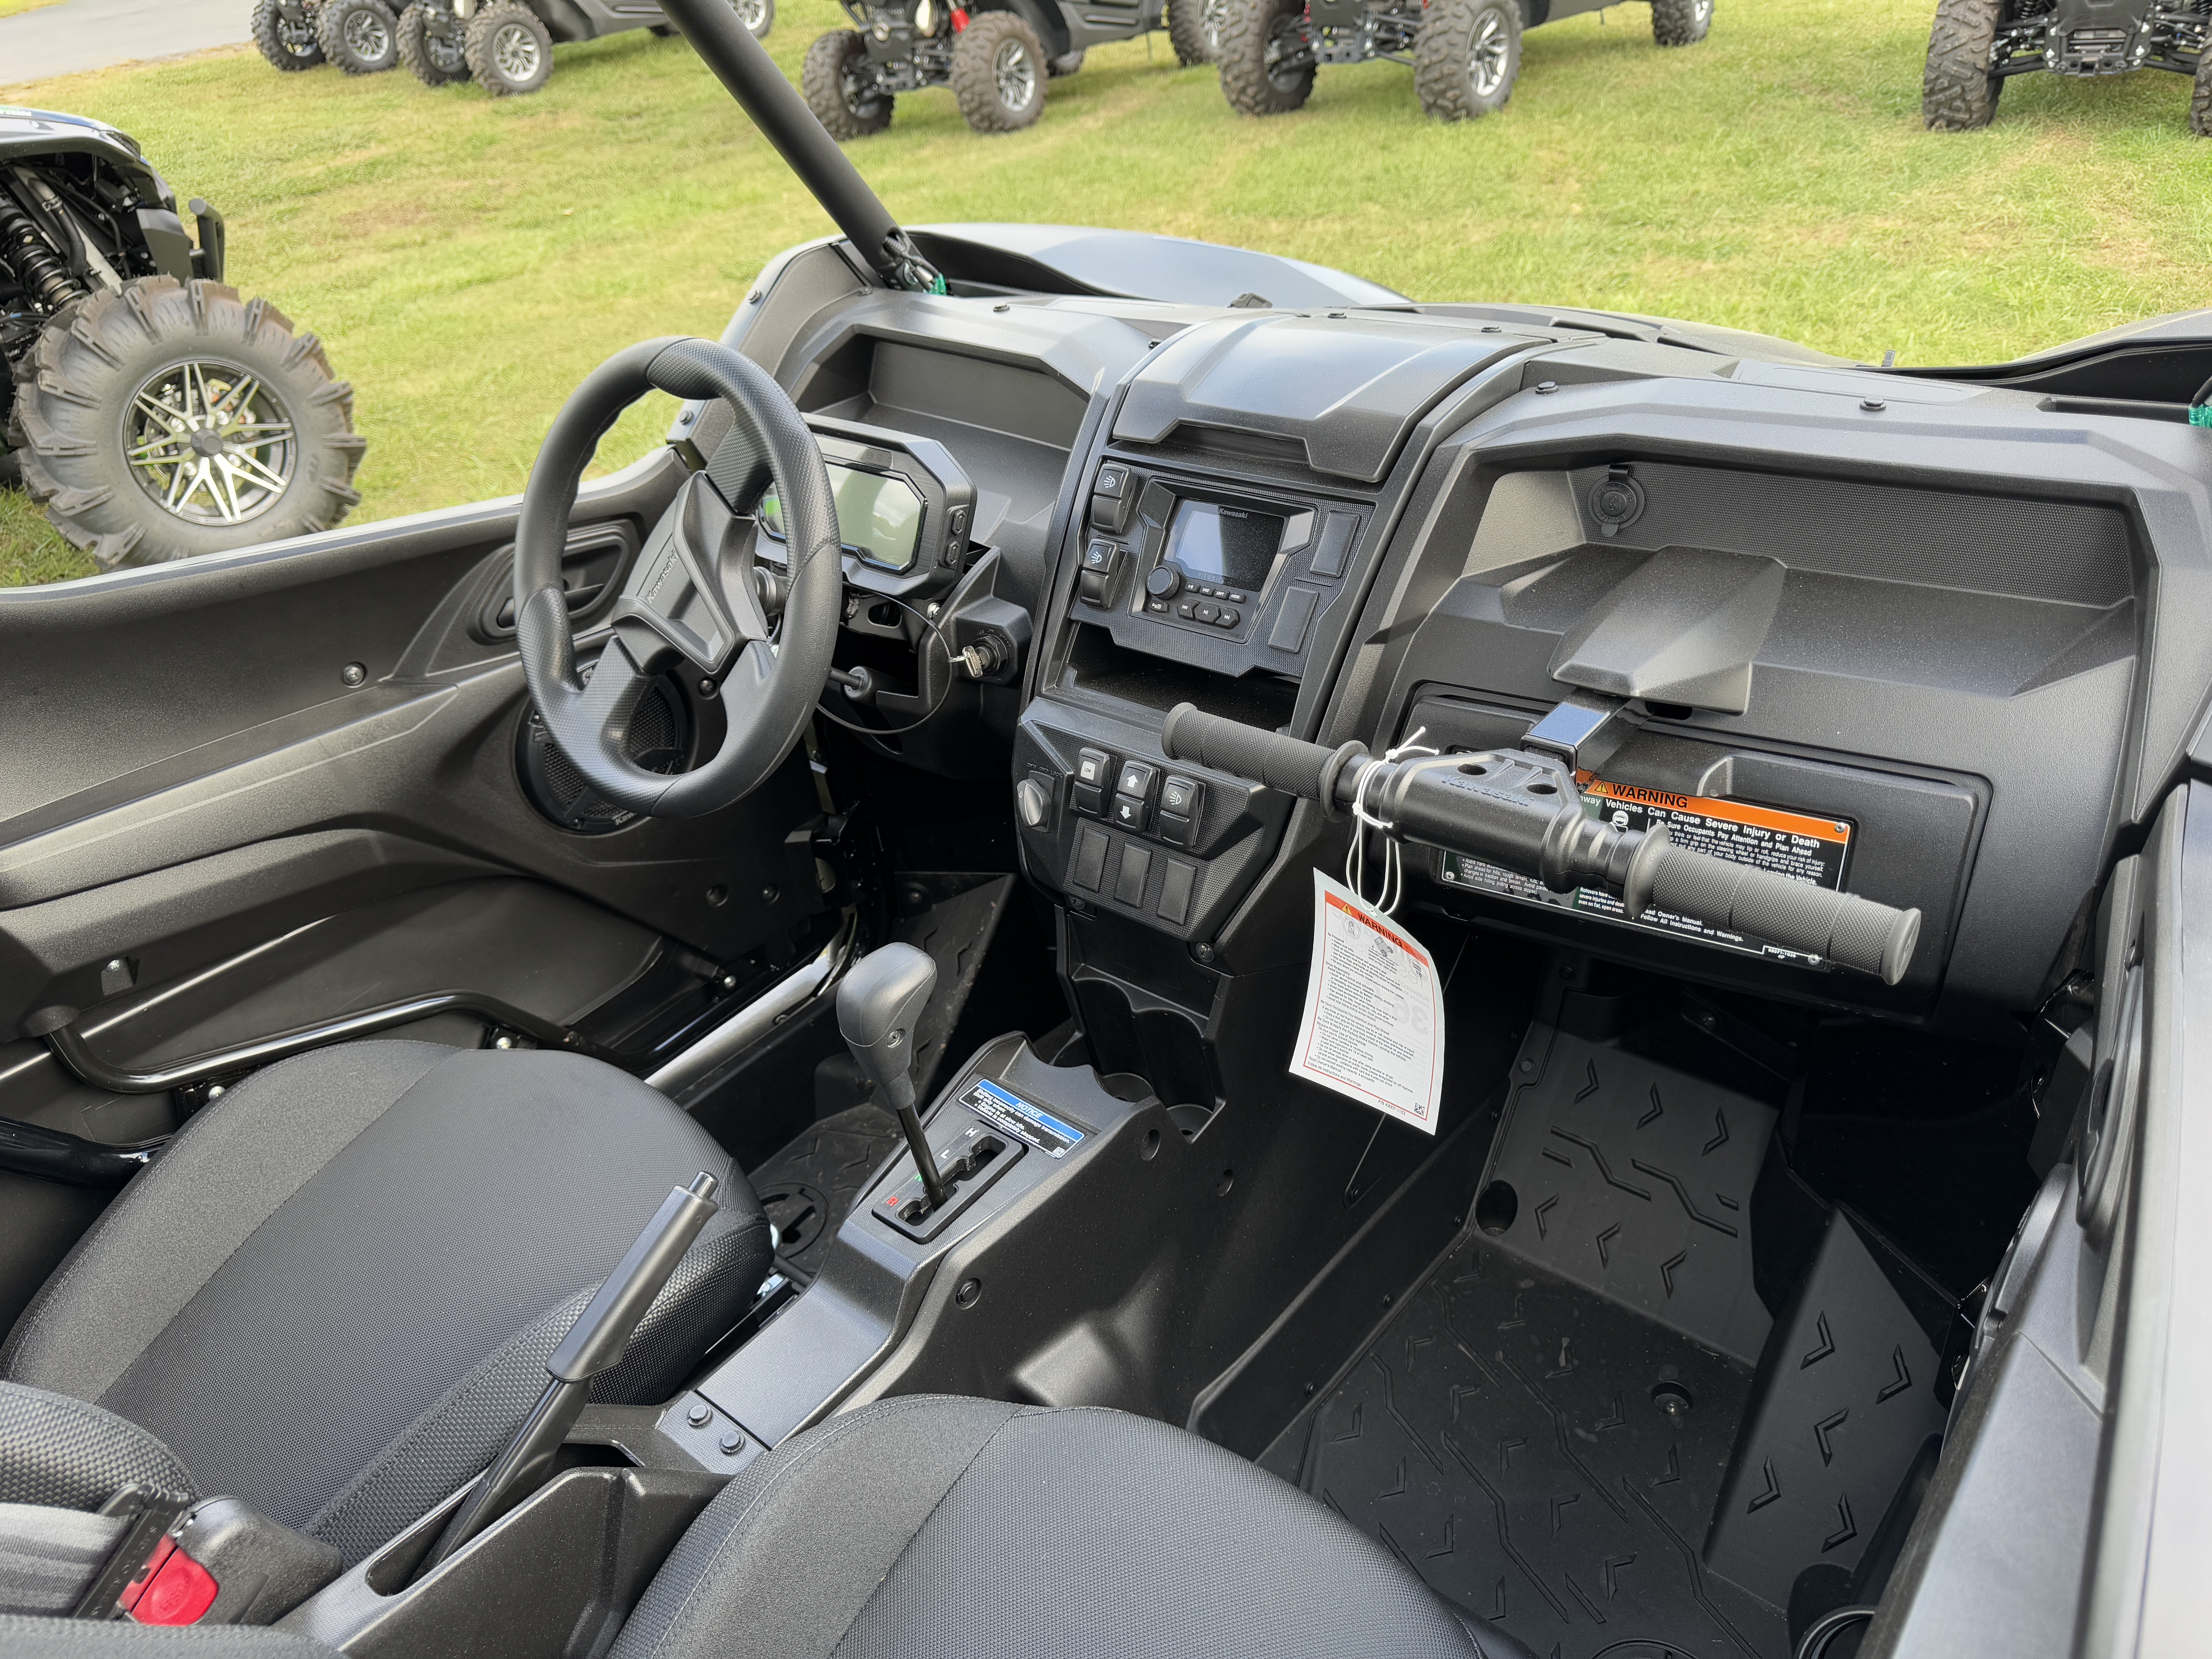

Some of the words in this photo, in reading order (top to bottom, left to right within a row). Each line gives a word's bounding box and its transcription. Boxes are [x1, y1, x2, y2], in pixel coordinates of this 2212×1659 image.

[1219, 508, 1248, 519] Kawasaki
[1597, 511, 1626, 523] OUTLET
[646, 549, 678, 604] Kawasaki
[1197, 572, 1225, 583] HIFONICS
[1441, 775, 1535, 807] Kawasaki
[1612, 783, 1688, 809] WARNING
[1606, 799, 1643, 814] Vehicles
[1647, 807, 1666, 818] Can
[1671, 811, 1700, 825] Cause
[1705, 817, 1738, 832] Severe
[1743, 825, 1771, 841] Injury
[1775, 833, 1787, 842] or
[1791, 835, 1820, 849] Death
[1667, 821, 1681, 830] Sure
[1683, 824, 1715, 839] Occupants
[1717, 831, 1729, 841] Pay
[1731, 833, 1759, 846] Attention
[1760, 840, 1773, 848] and
[1775, 842, 1790, 852] Plan
[1791, 845, 1812, 857] Ahead
[1717, 845, 1734, 855] steering
[1757, 853, 1778, 864] handgrips
[1791, 860, 1803, 868] brace
[1719, 840, 1734, 848] vehicle
[1771, 850, 1786, 859] reduce
[1725, 852, 1736, 861] body
[1738, 855, 1753, 864] outside
[1771, 862, 1786, 870] vehicle
[1464, 868, 1479, 876] changes
[1657, 910, 1680, 921] Owner's
[1681, 916, 1703, 926] Manual.
[1358, 912, 1403, 948] WARNING
[1640, 913, 1658, 922] Follow
[1669, 919, 1701, 932] Instructions
[1703, 927, 1714, 935] and
[1716, 930, 1744, 943] Warnings.
[1015, 1102, 1043, 1119] NOTICE
[1023, 1116, 1042, 1128] damage
[965, 1127, 978, 1137] H
[940, 1149, 950, 1159] L
[886, 1196, 899, 1206] R
